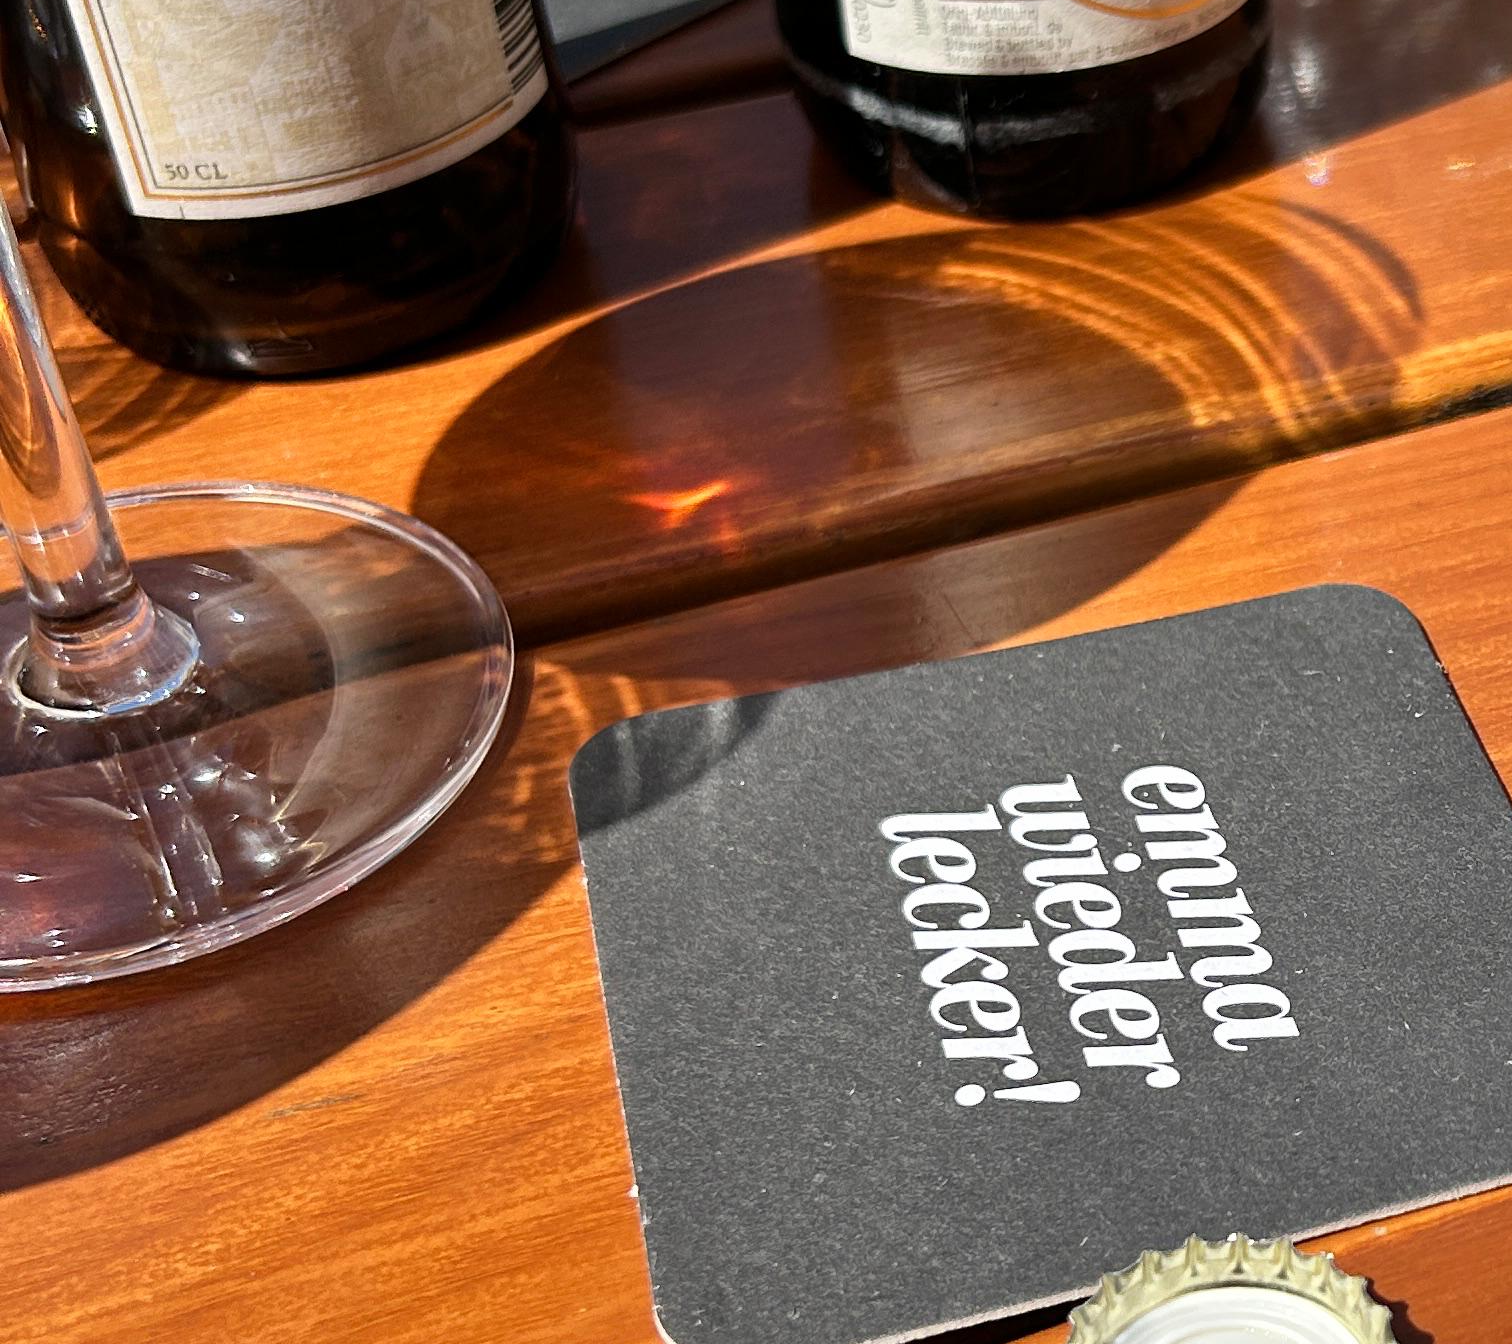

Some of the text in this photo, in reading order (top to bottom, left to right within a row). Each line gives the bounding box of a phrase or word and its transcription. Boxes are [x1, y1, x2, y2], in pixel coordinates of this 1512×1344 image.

[165, 162, 228, 180] 50 CL
[879, 803, 1081, 1106] lecker!
[999, 774, 1181, 1088] wieder
[1121, 765, 1299, 1052] emma
